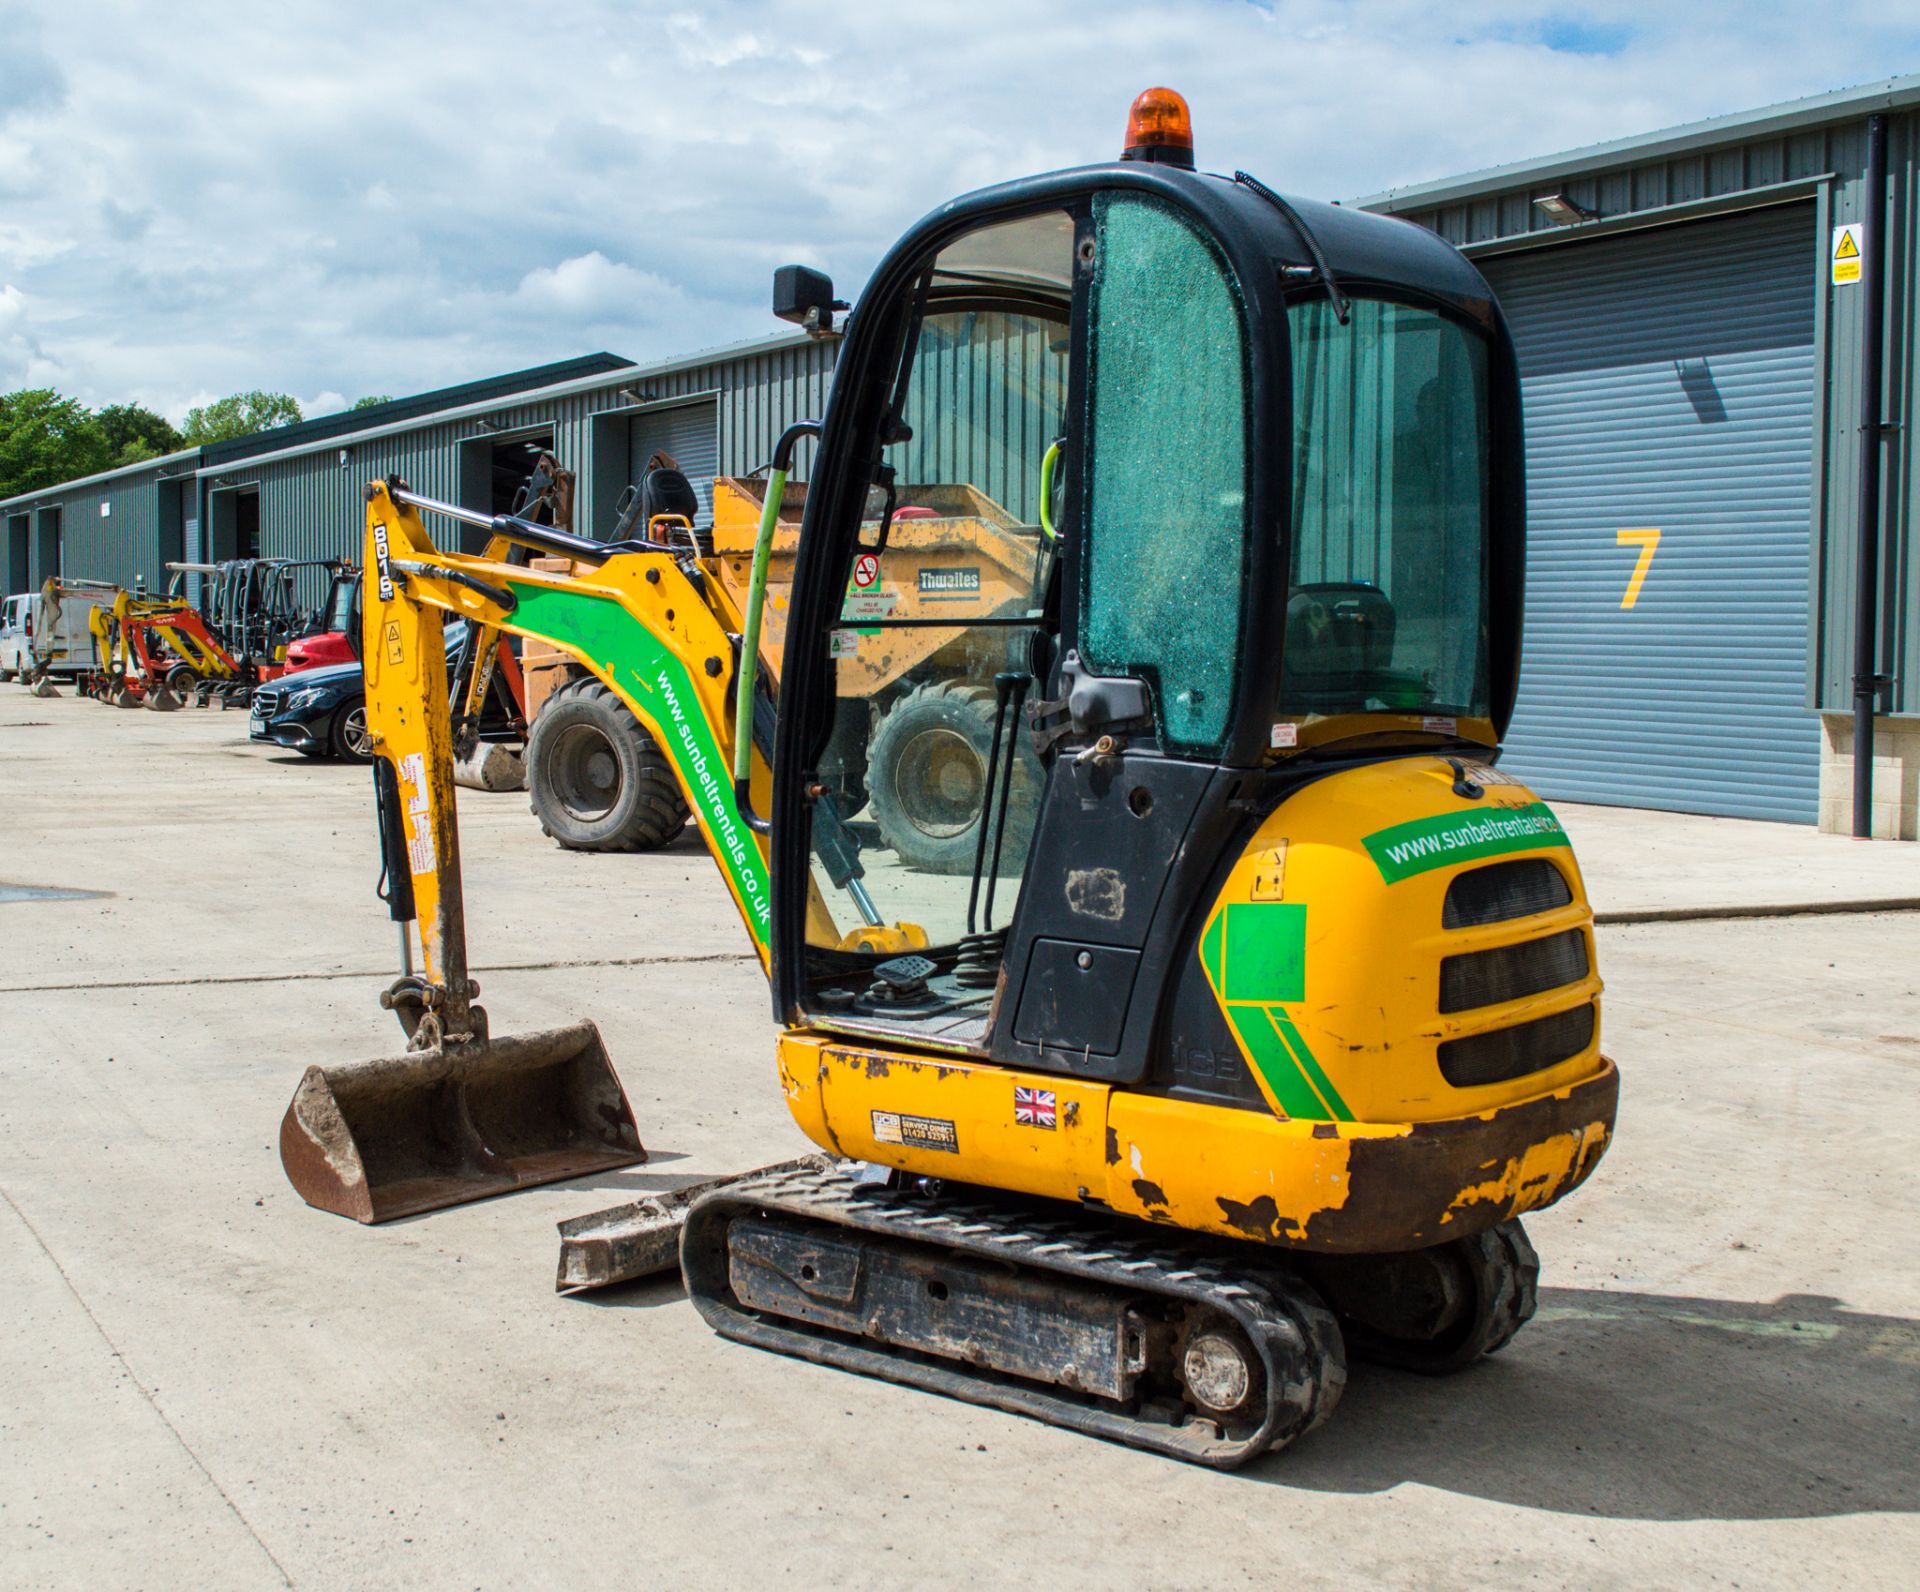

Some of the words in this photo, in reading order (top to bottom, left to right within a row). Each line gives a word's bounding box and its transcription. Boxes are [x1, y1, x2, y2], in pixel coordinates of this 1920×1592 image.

[374, 525, 393, 592] 8016
[1616, 528, 1662, 608] 7
[920, 572, 979, 588] Thwaites
[657, 670, 770, 924] www.sunbeltrentals.co.uk
[875, 1113, 899, 1127] JCB
[902, 1120, 929, 1131] SERVICE
[930, 1125, 954, 1134] DIRECT
